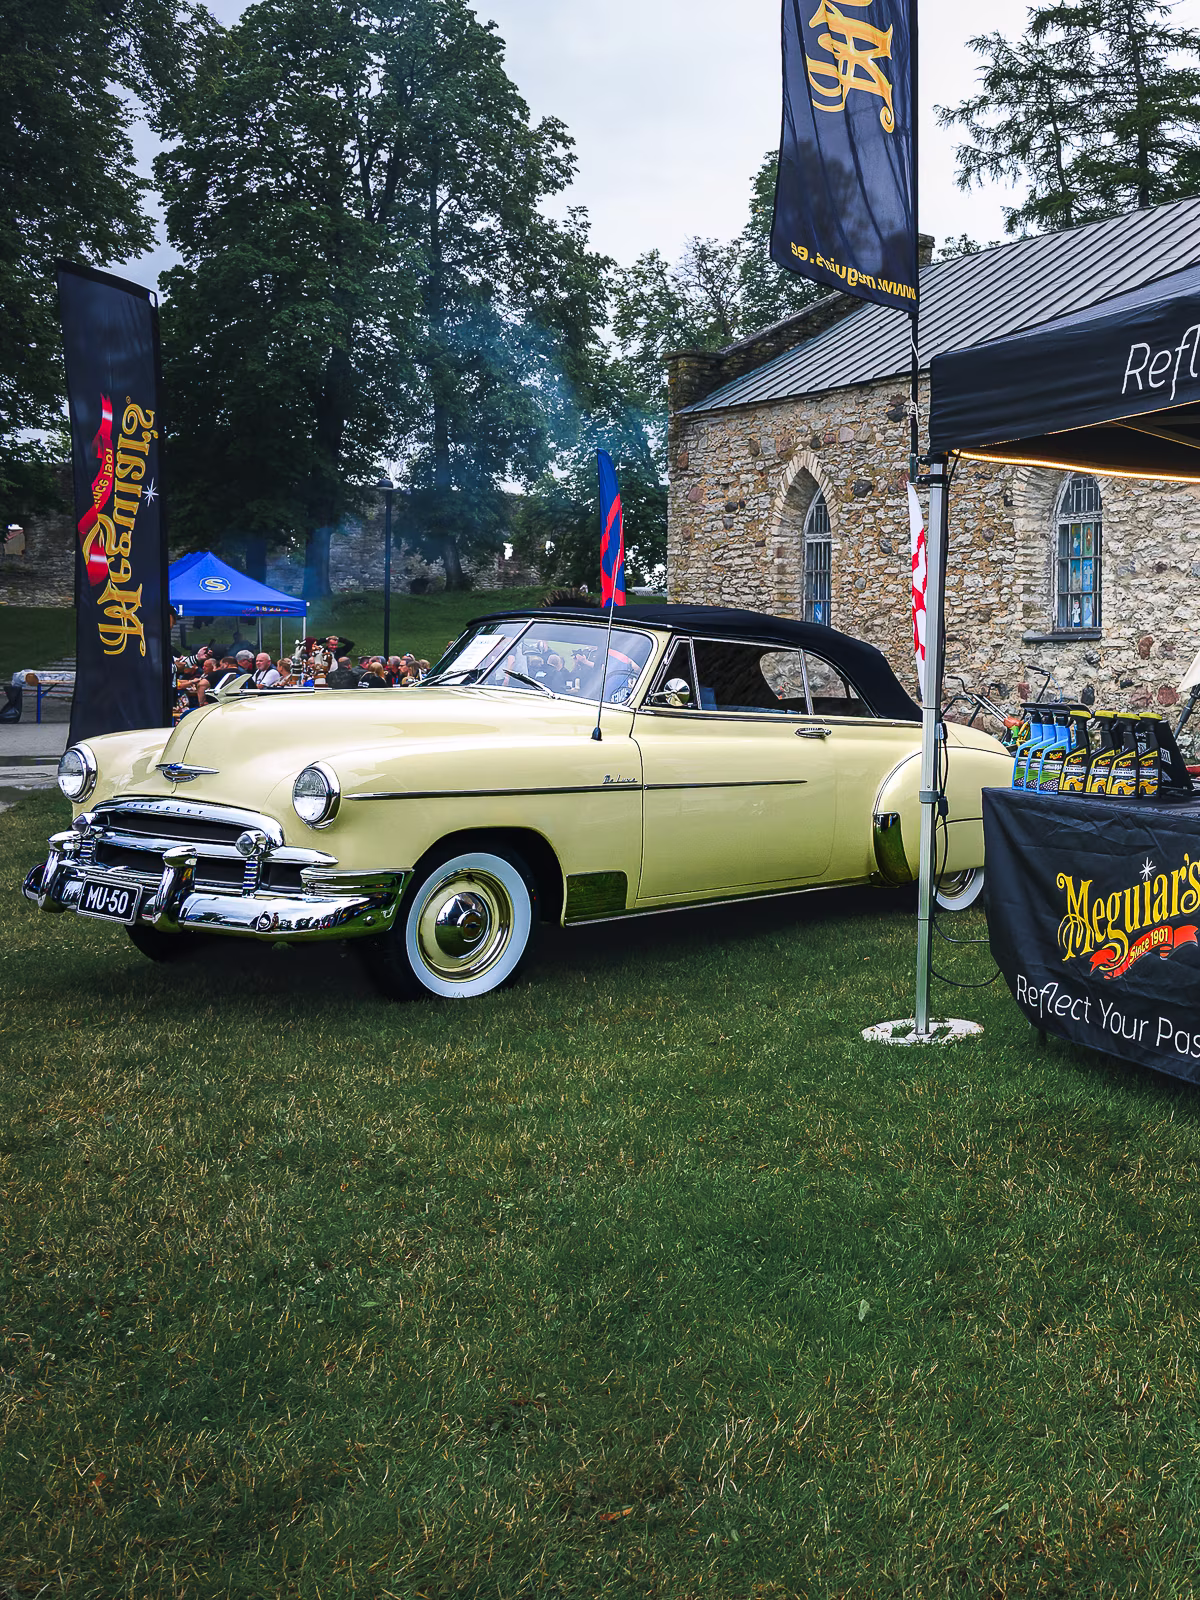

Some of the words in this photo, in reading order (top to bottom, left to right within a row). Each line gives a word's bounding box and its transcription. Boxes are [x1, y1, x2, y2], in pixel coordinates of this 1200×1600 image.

[1129, 939, 1150, 964] Since
[1151, 927, 1169, 946] 1901
[1016, 974, 1092, 1024] Reflect
[1099, 998, 1150, 1042] Your
